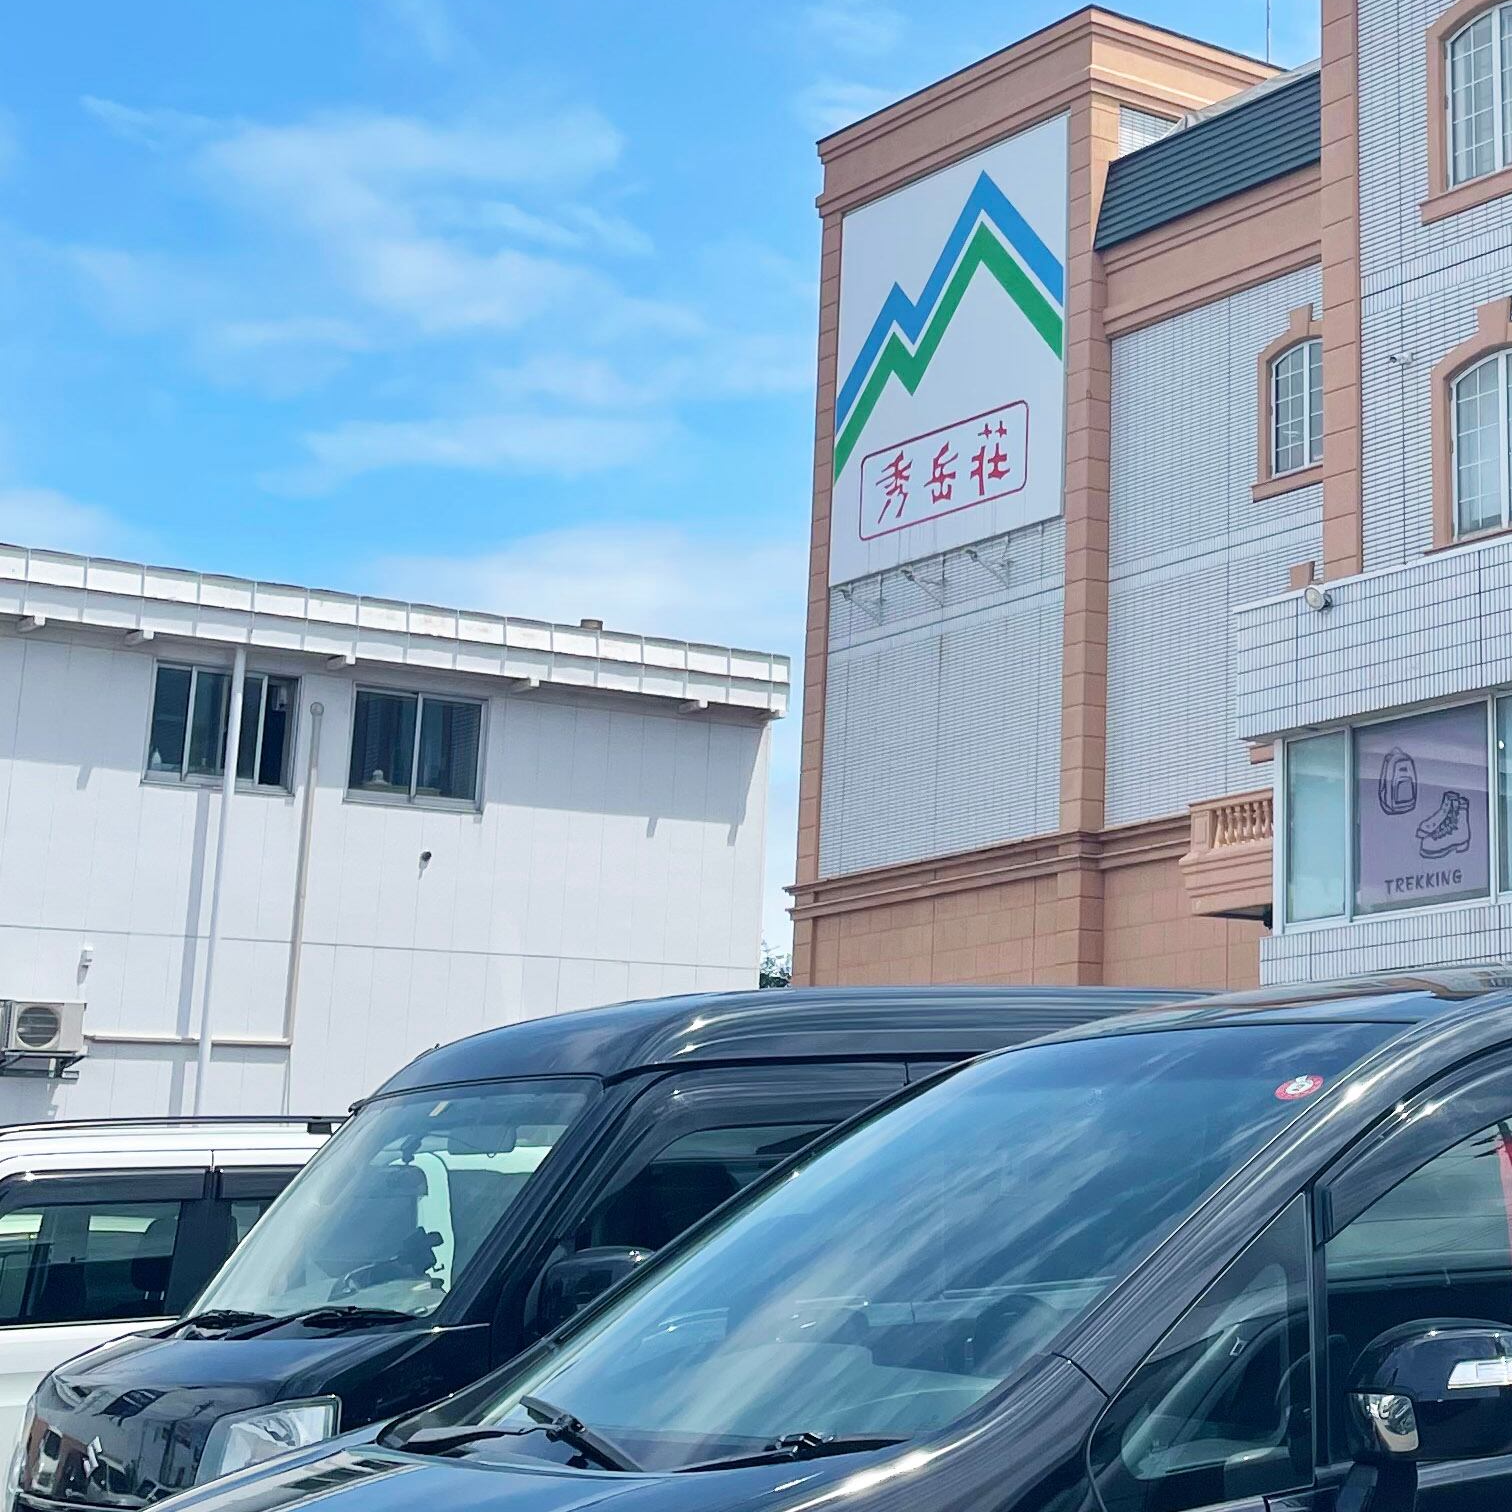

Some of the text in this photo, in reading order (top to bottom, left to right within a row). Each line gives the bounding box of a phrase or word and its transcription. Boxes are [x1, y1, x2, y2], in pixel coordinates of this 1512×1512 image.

[876, 420, 1010, 524] 秀岳荘
[1384, 869, 1462, 896] TREKKING
